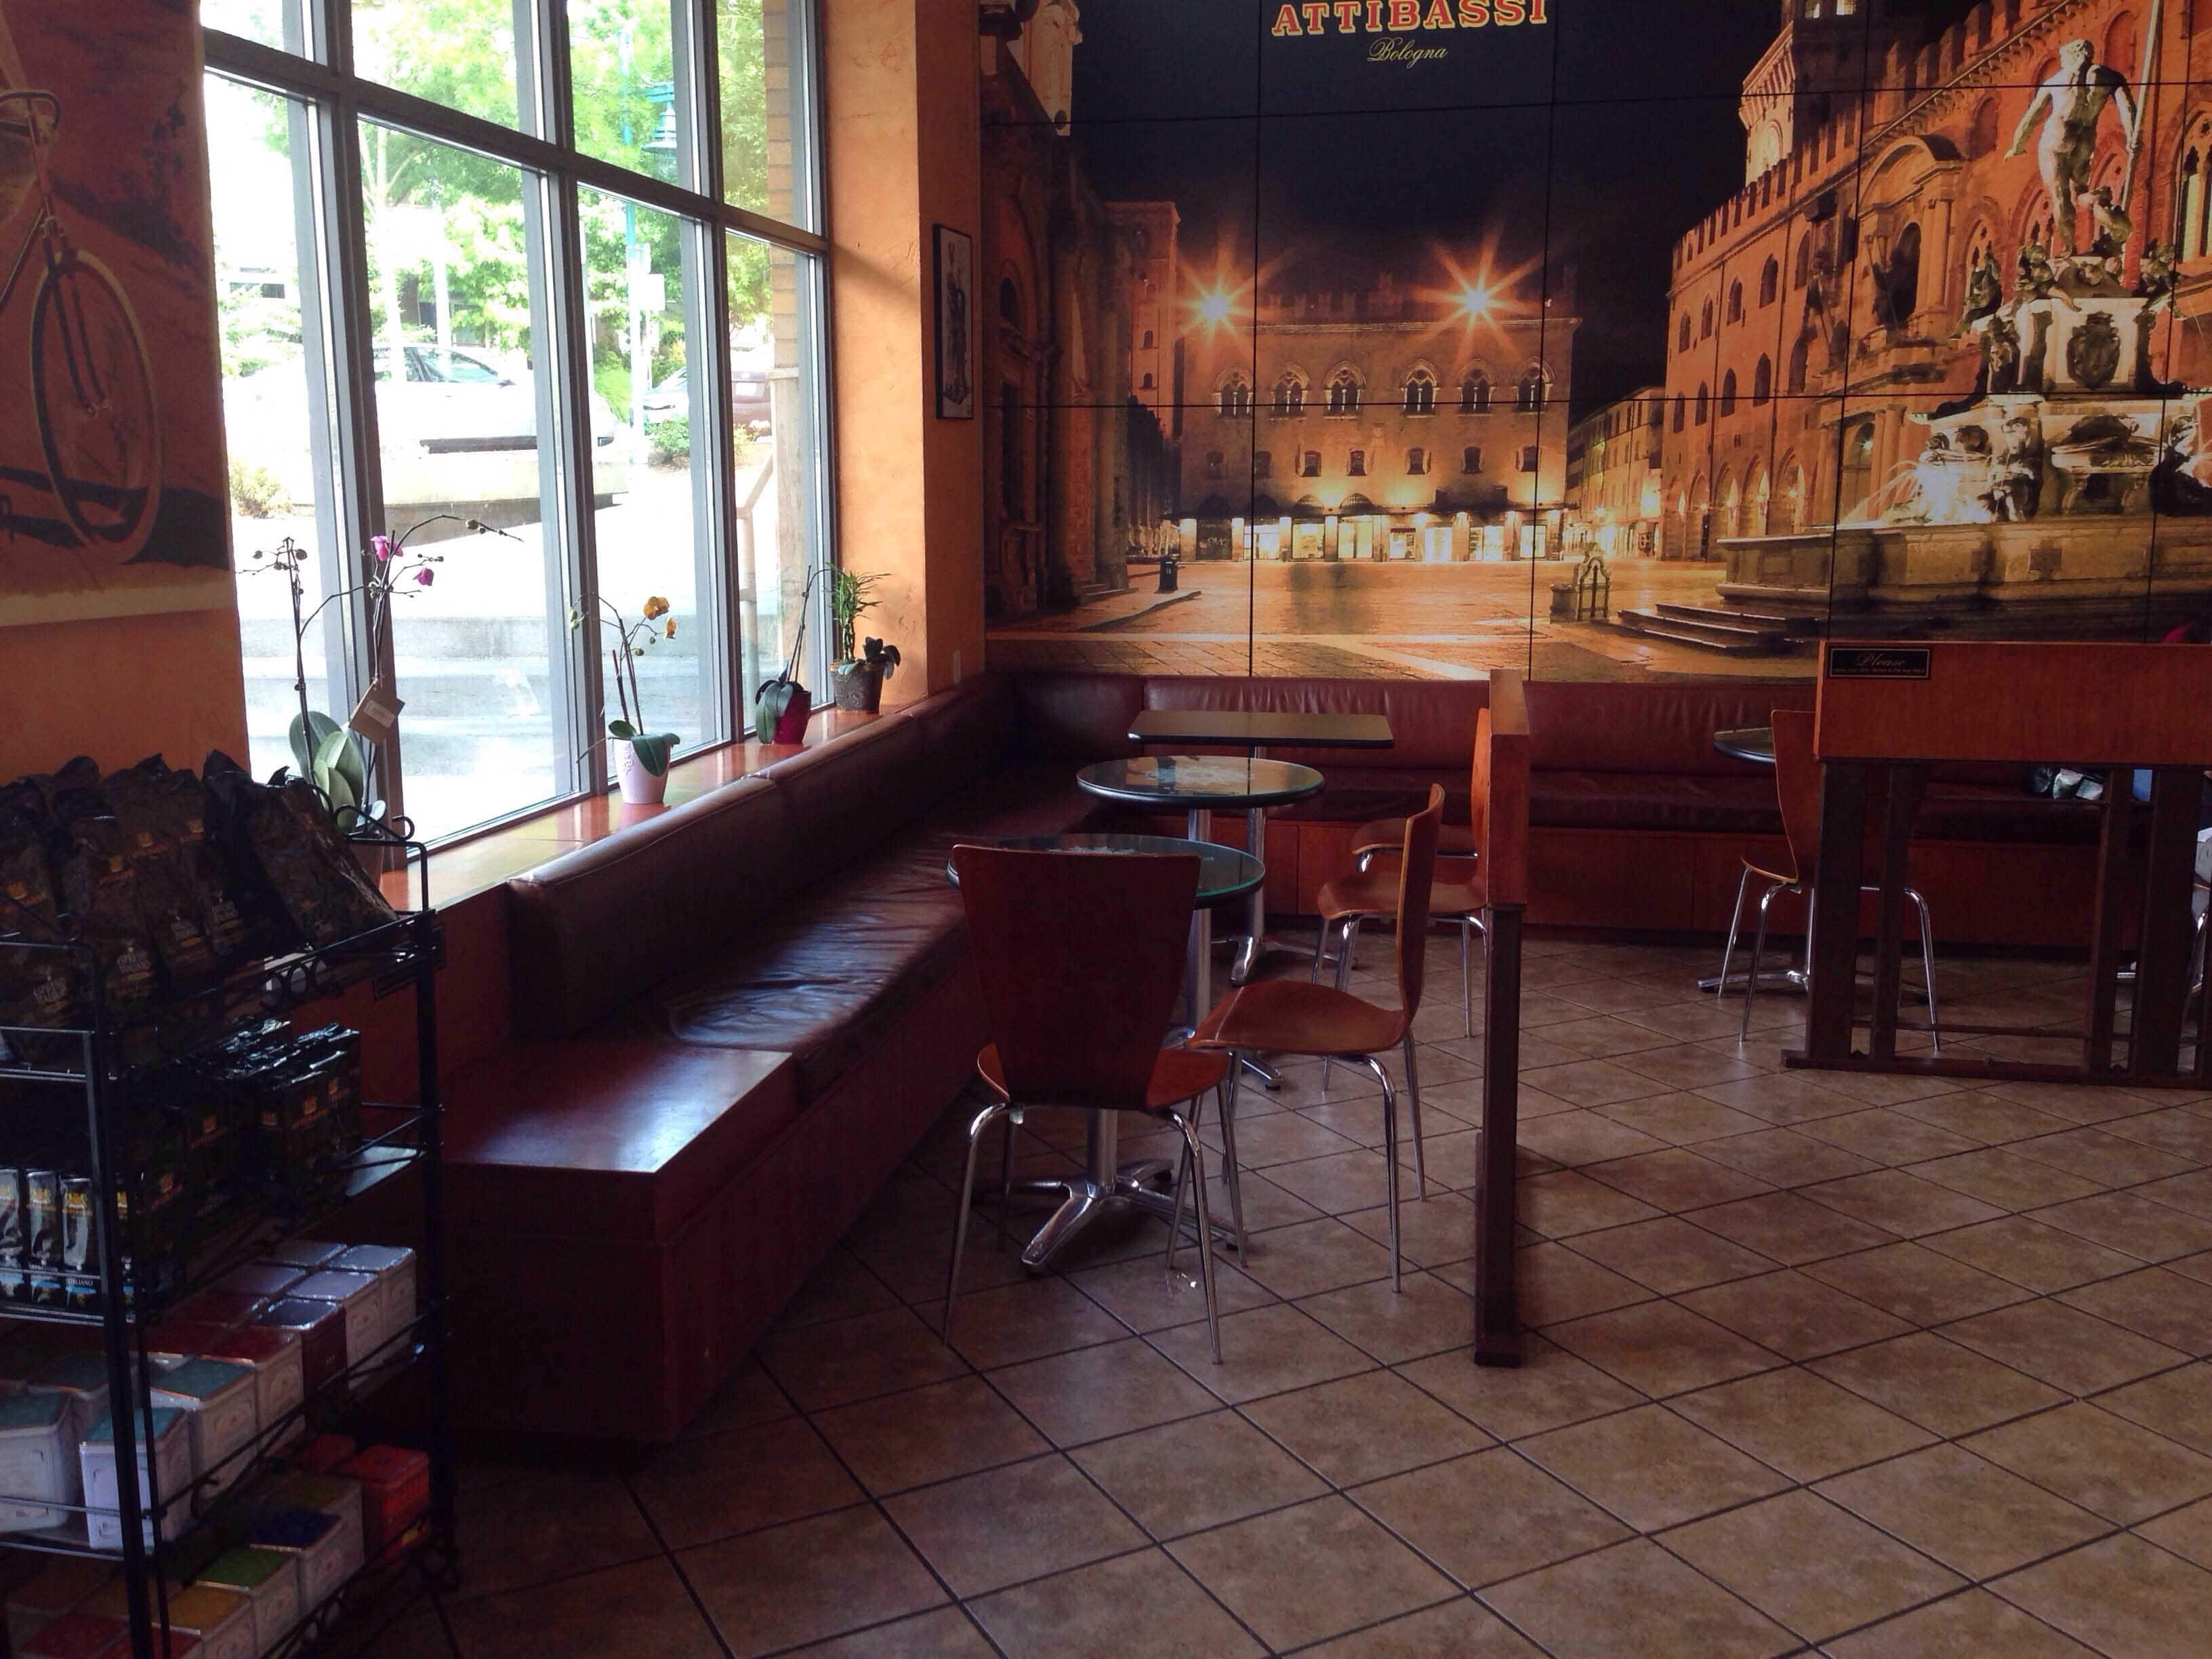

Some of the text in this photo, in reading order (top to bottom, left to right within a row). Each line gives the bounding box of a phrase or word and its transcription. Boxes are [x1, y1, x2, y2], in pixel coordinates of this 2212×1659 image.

[1271, 0, 1547, 37] ATTIBASSI
[1367, 37, 1448, 68] Bologna
[1855, 652, 1906, 667] Please
